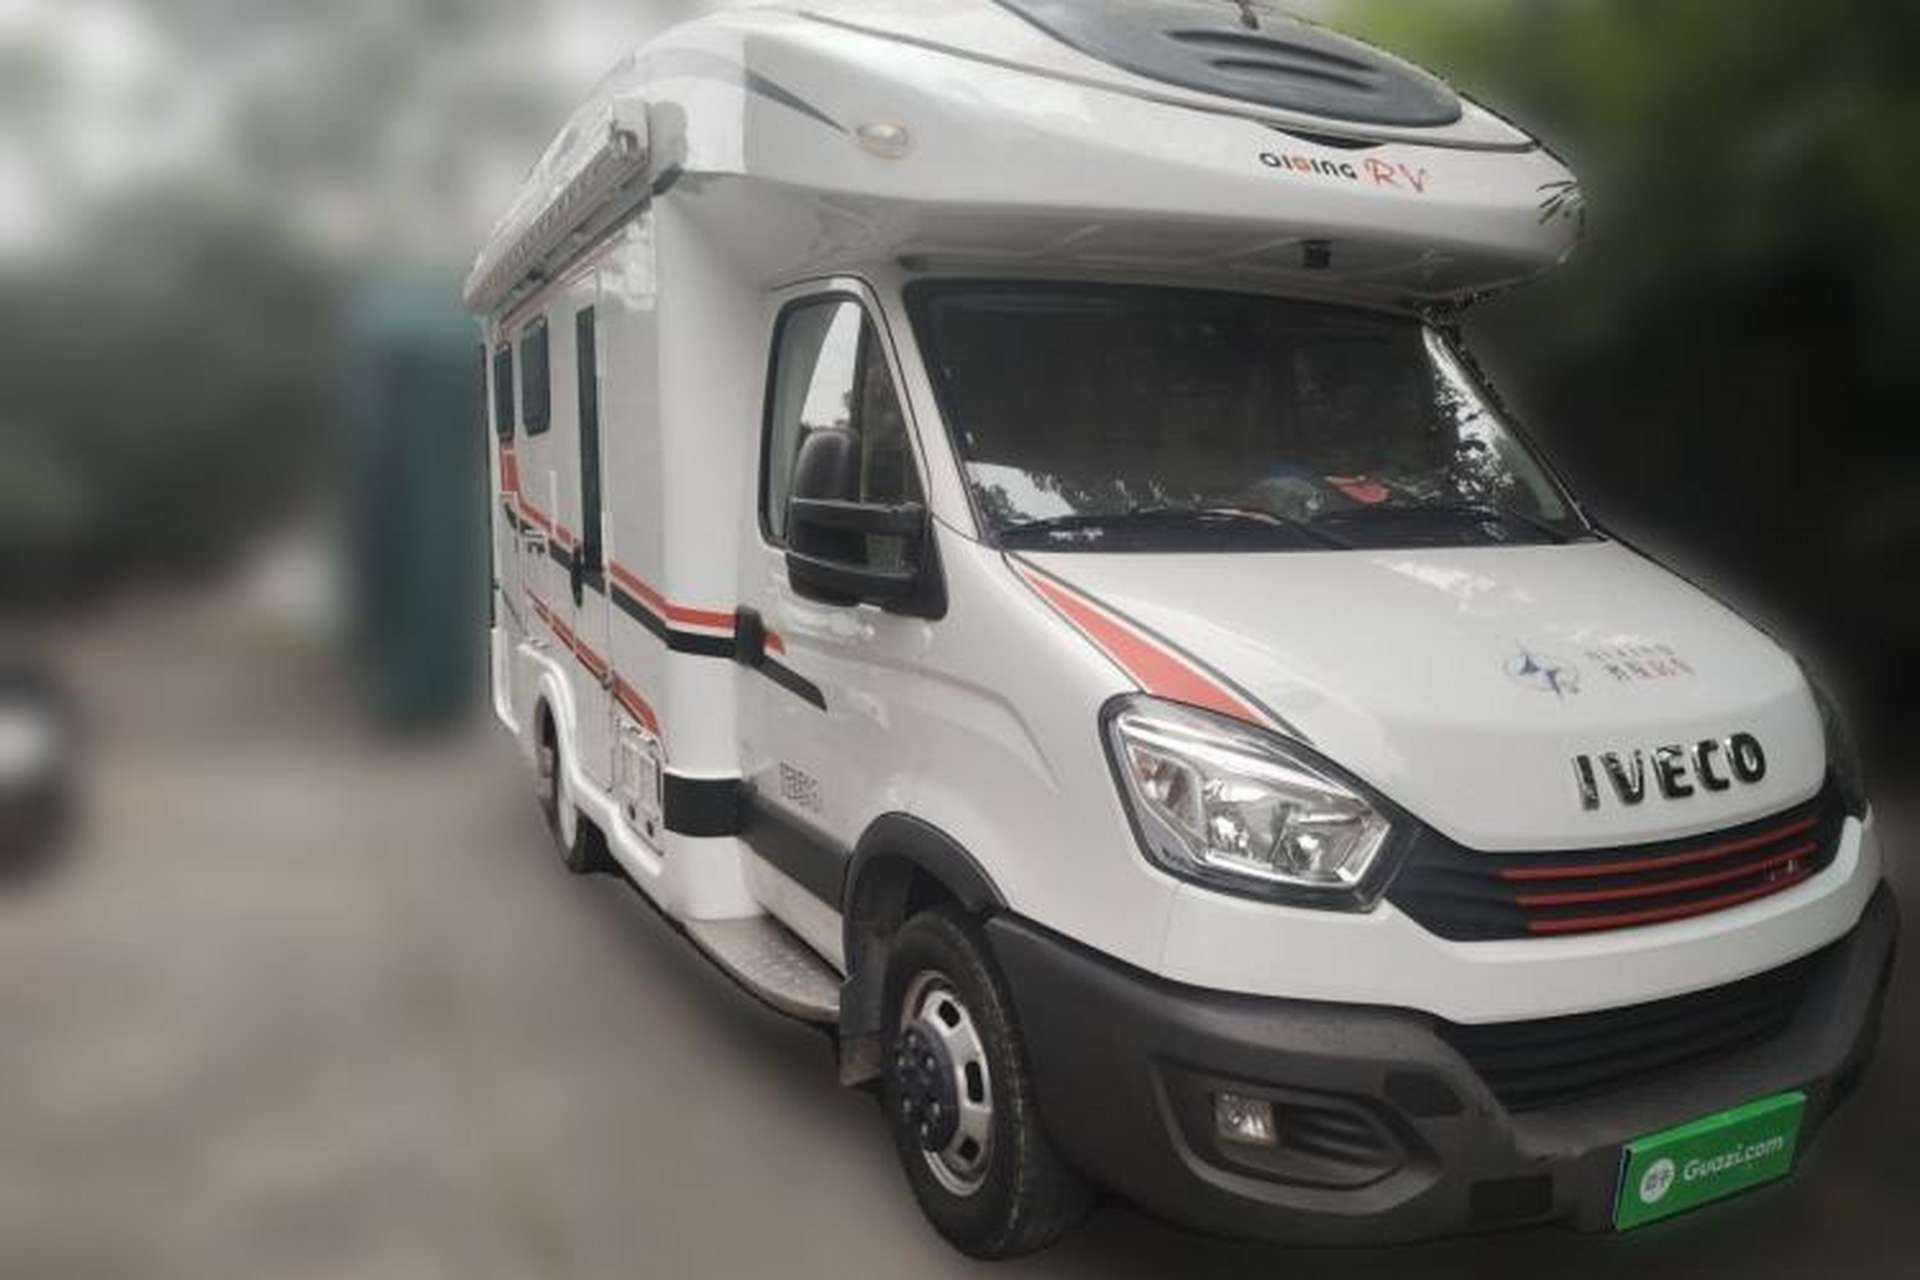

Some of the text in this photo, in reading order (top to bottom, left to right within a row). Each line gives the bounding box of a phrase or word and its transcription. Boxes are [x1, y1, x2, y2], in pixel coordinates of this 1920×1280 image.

[1364, 157, 1427, 194] RV
[1571, 731, 1767, 812] IVECO
[1683, 1135, 1784, 1181] Guazi.com
